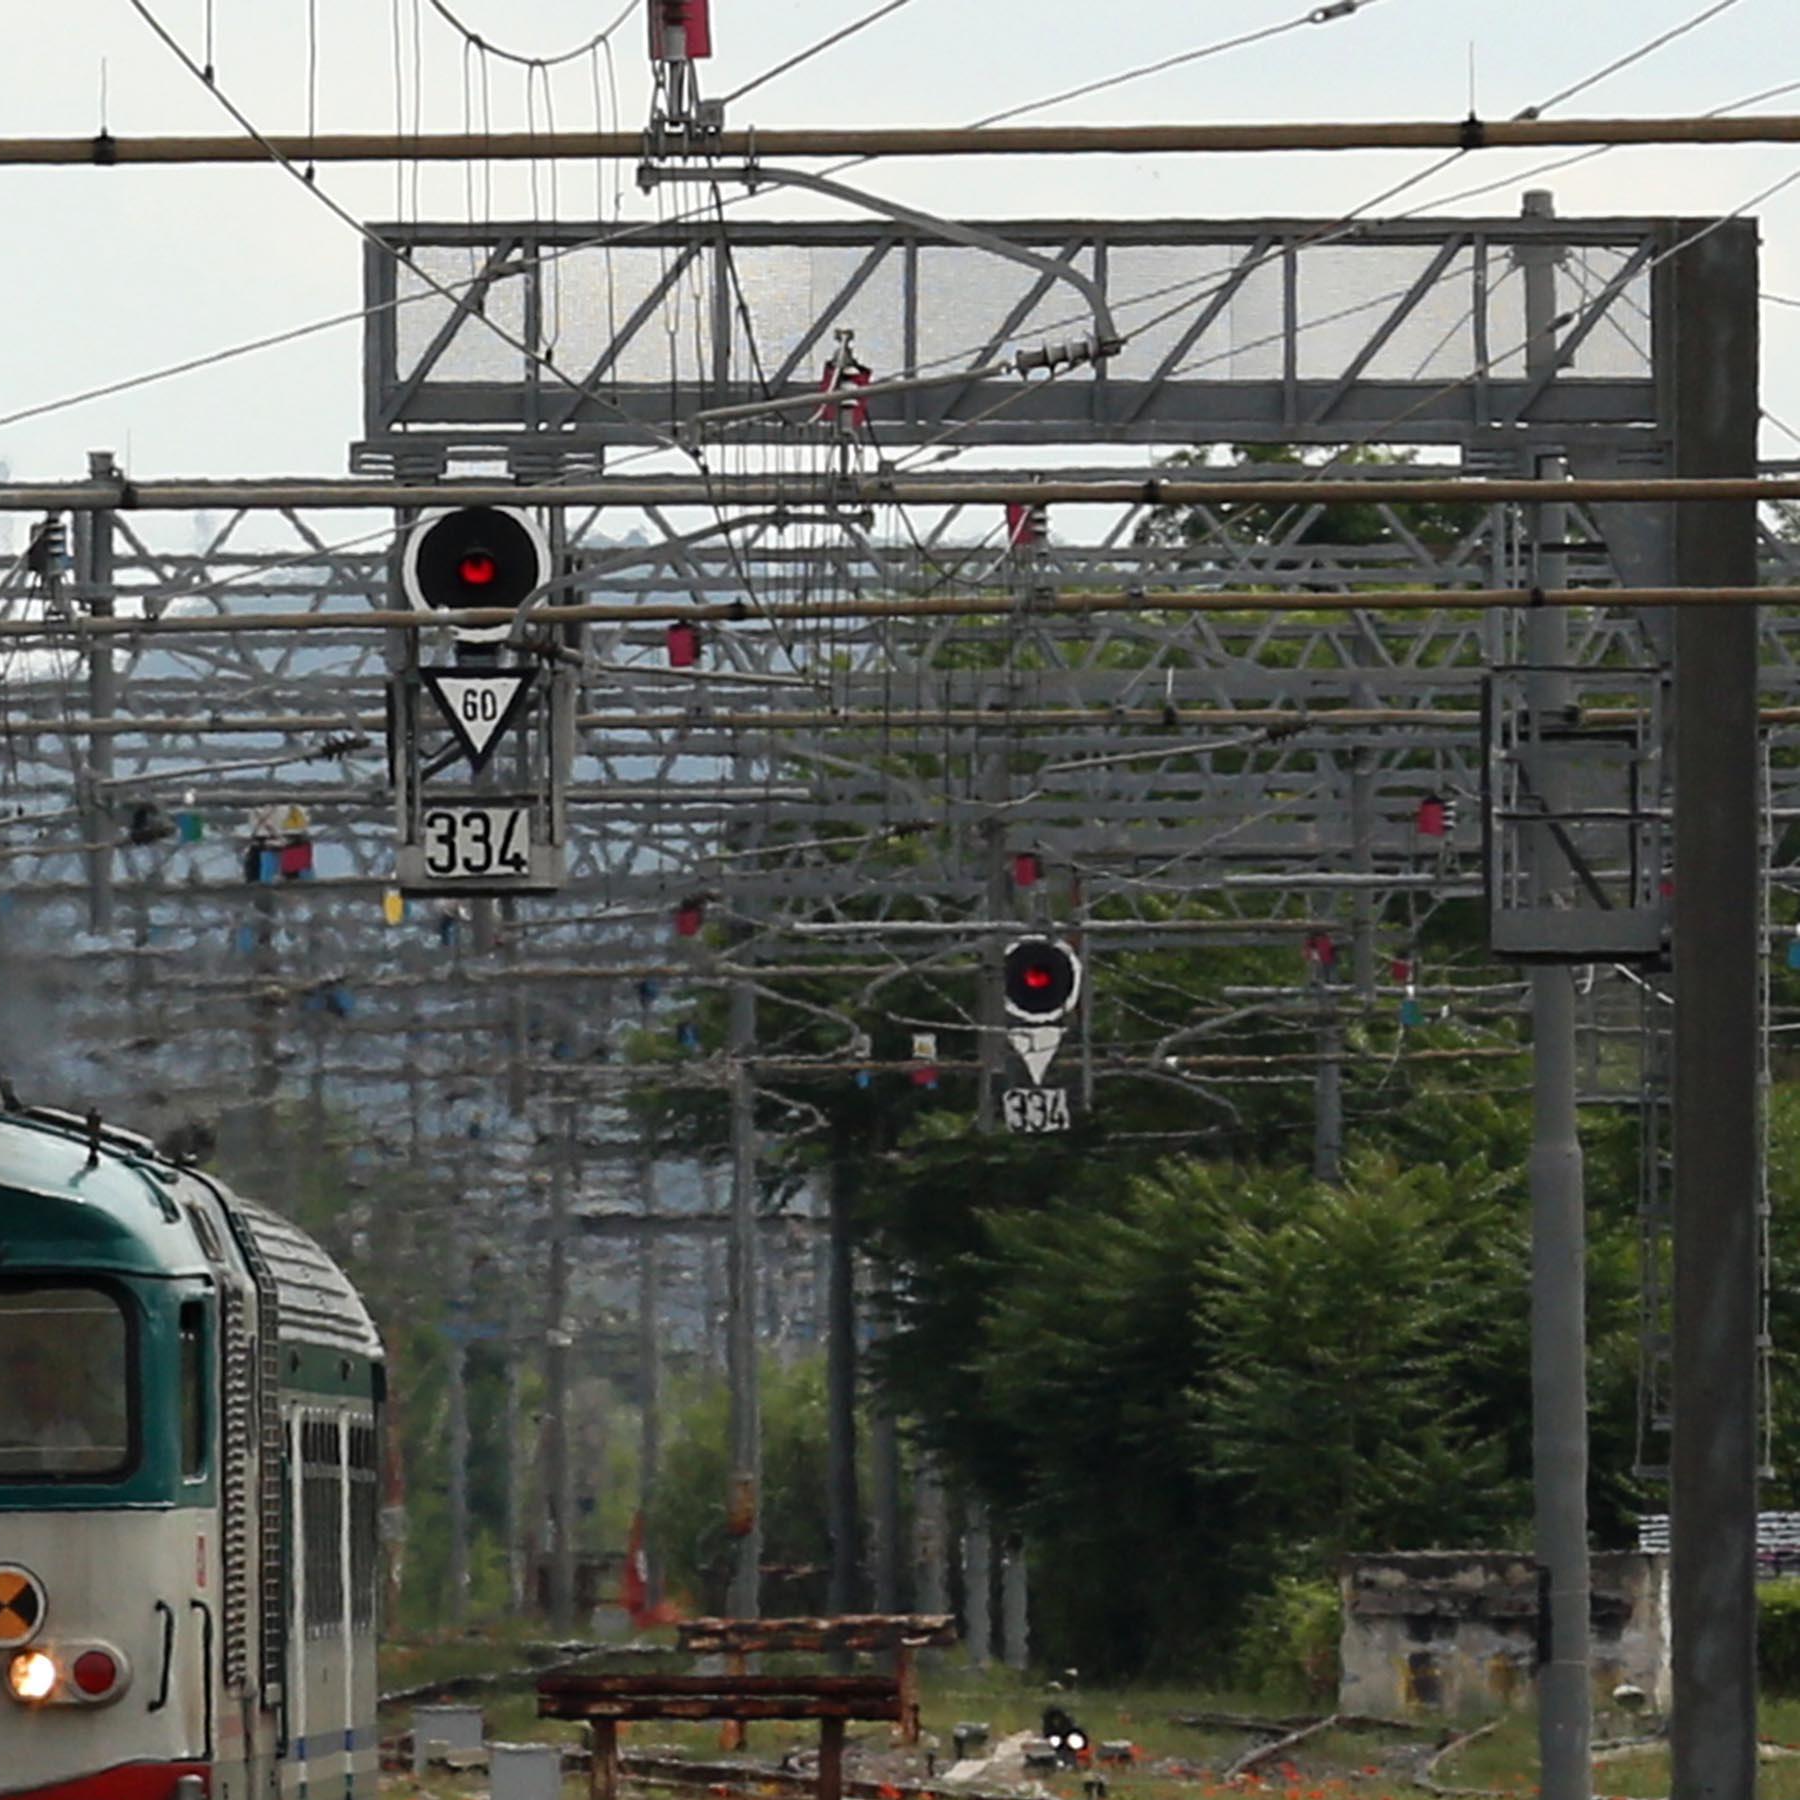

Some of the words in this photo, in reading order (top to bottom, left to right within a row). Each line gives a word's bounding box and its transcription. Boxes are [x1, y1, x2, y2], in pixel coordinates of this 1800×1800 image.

[463, 689, 497, 721] 60
[427, 810, 527, 873] 334
[1008, 1090, 1066, 1134] 334
